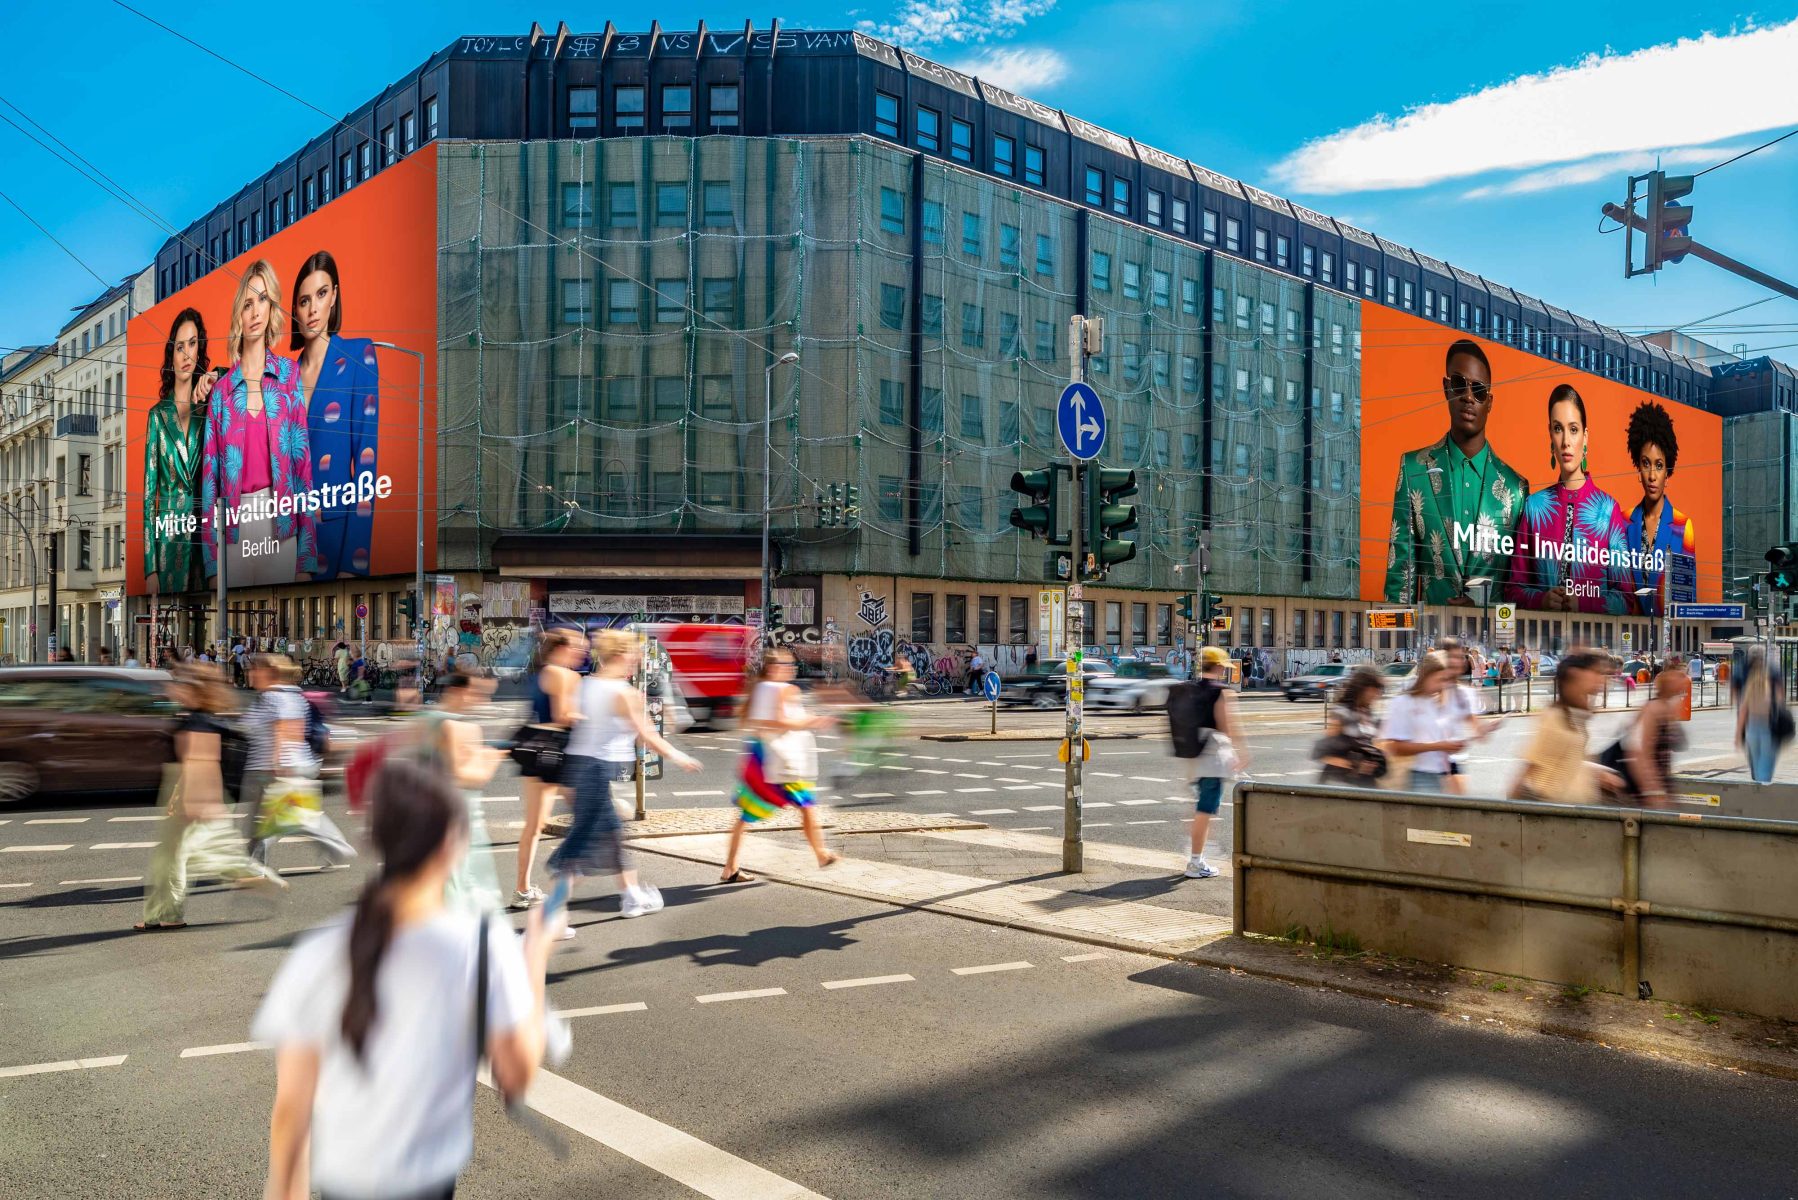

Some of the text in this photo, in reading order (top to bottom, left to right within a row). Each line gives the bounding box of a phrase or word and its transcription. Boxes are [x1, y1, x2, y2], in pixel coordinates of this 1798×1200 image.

[155, 511, 197, 539] Mitte
[241, 536, 280, 558] Berlin
[1453, 521, 1514, 556] Mitte
[1534, 532, 1664, 573] Invalidenstraß
[1564, 578, 1600, 599] Berlin
